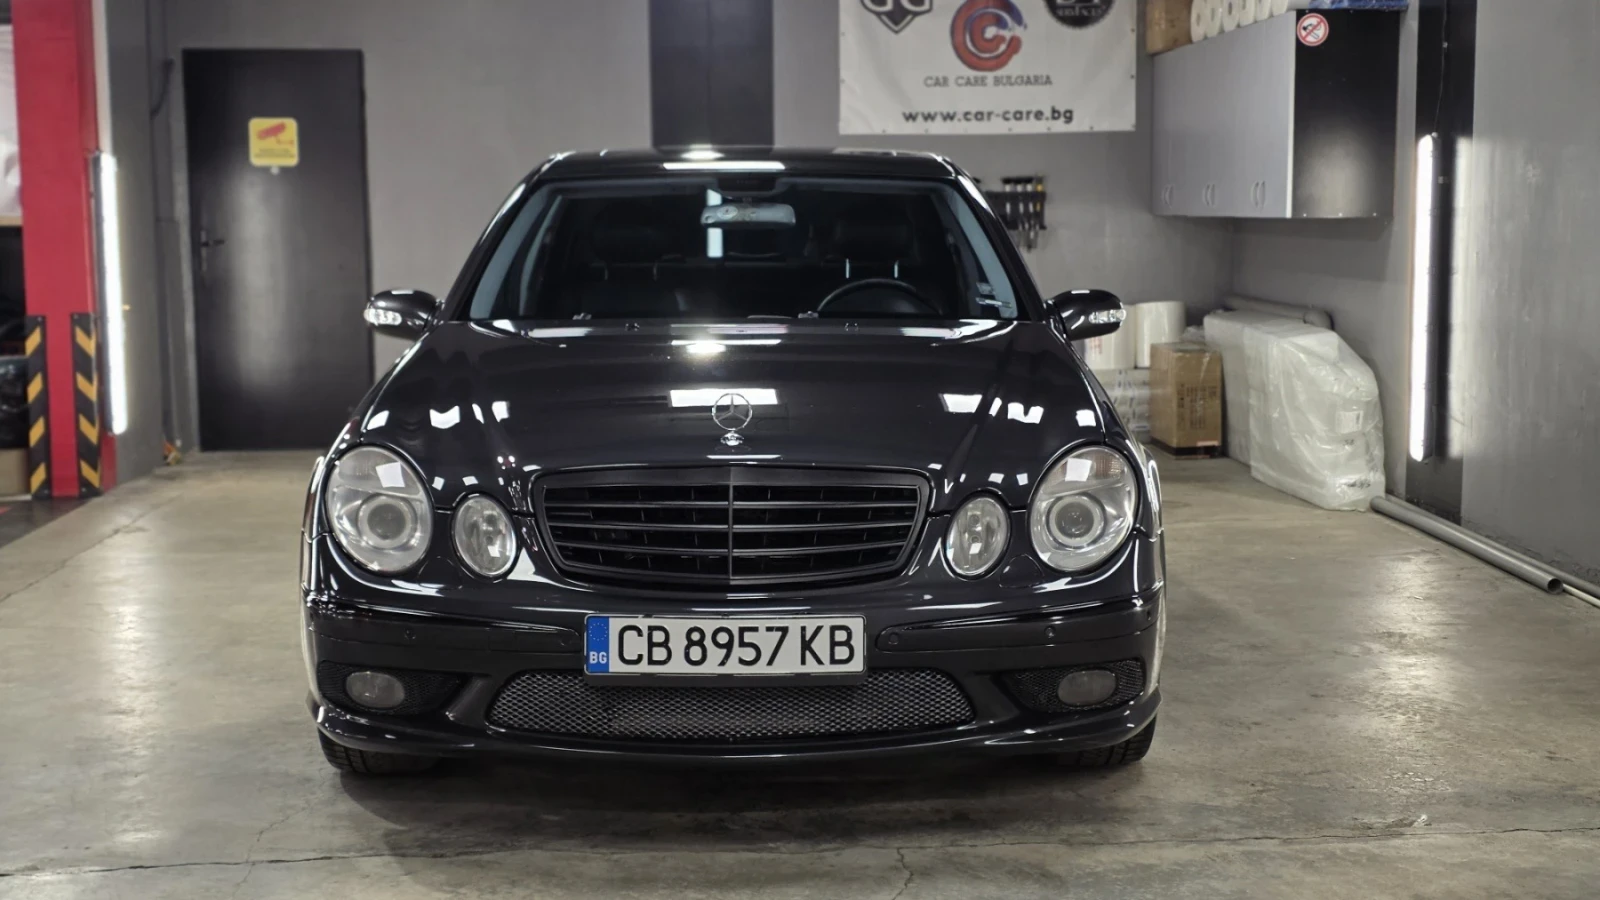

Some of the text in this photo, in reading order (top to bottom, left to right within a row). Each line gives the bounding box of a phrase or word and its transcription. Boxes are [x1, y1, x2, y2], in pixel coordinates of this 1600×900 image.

[924, 74, 1053, 87] CAR CARE BULGARIA
[902, 106, 1074, 125] www.car-care.bg
[618, 624, 855, 667] CB 8957 KB
[589, 651, 607, 664] BG
